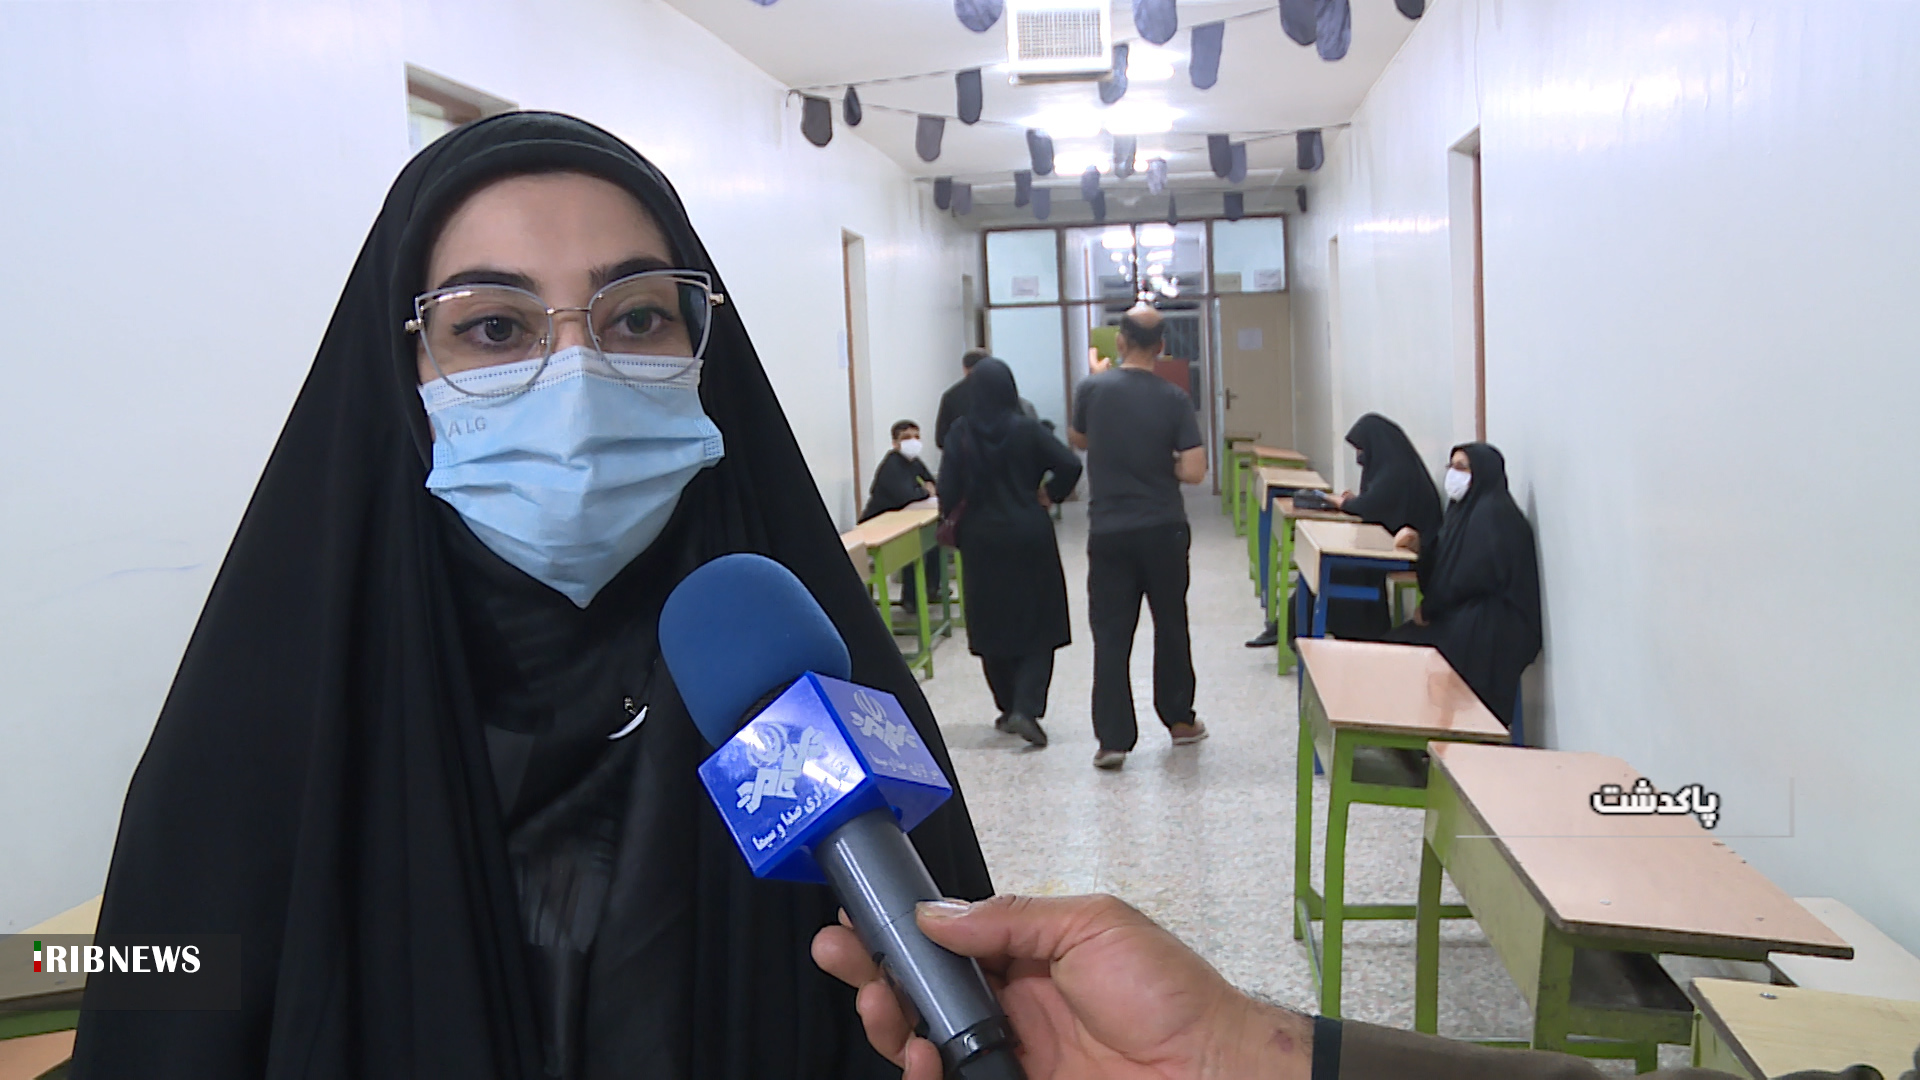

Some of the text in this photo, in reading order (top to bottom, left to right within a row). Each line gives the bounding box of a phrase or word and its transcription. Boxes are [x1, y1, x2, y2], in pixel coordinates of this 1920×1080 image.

[780, 805, 802, 826] صدا
[752, 829, 777, 851] سیما
[776, 823, 787, 839] و
